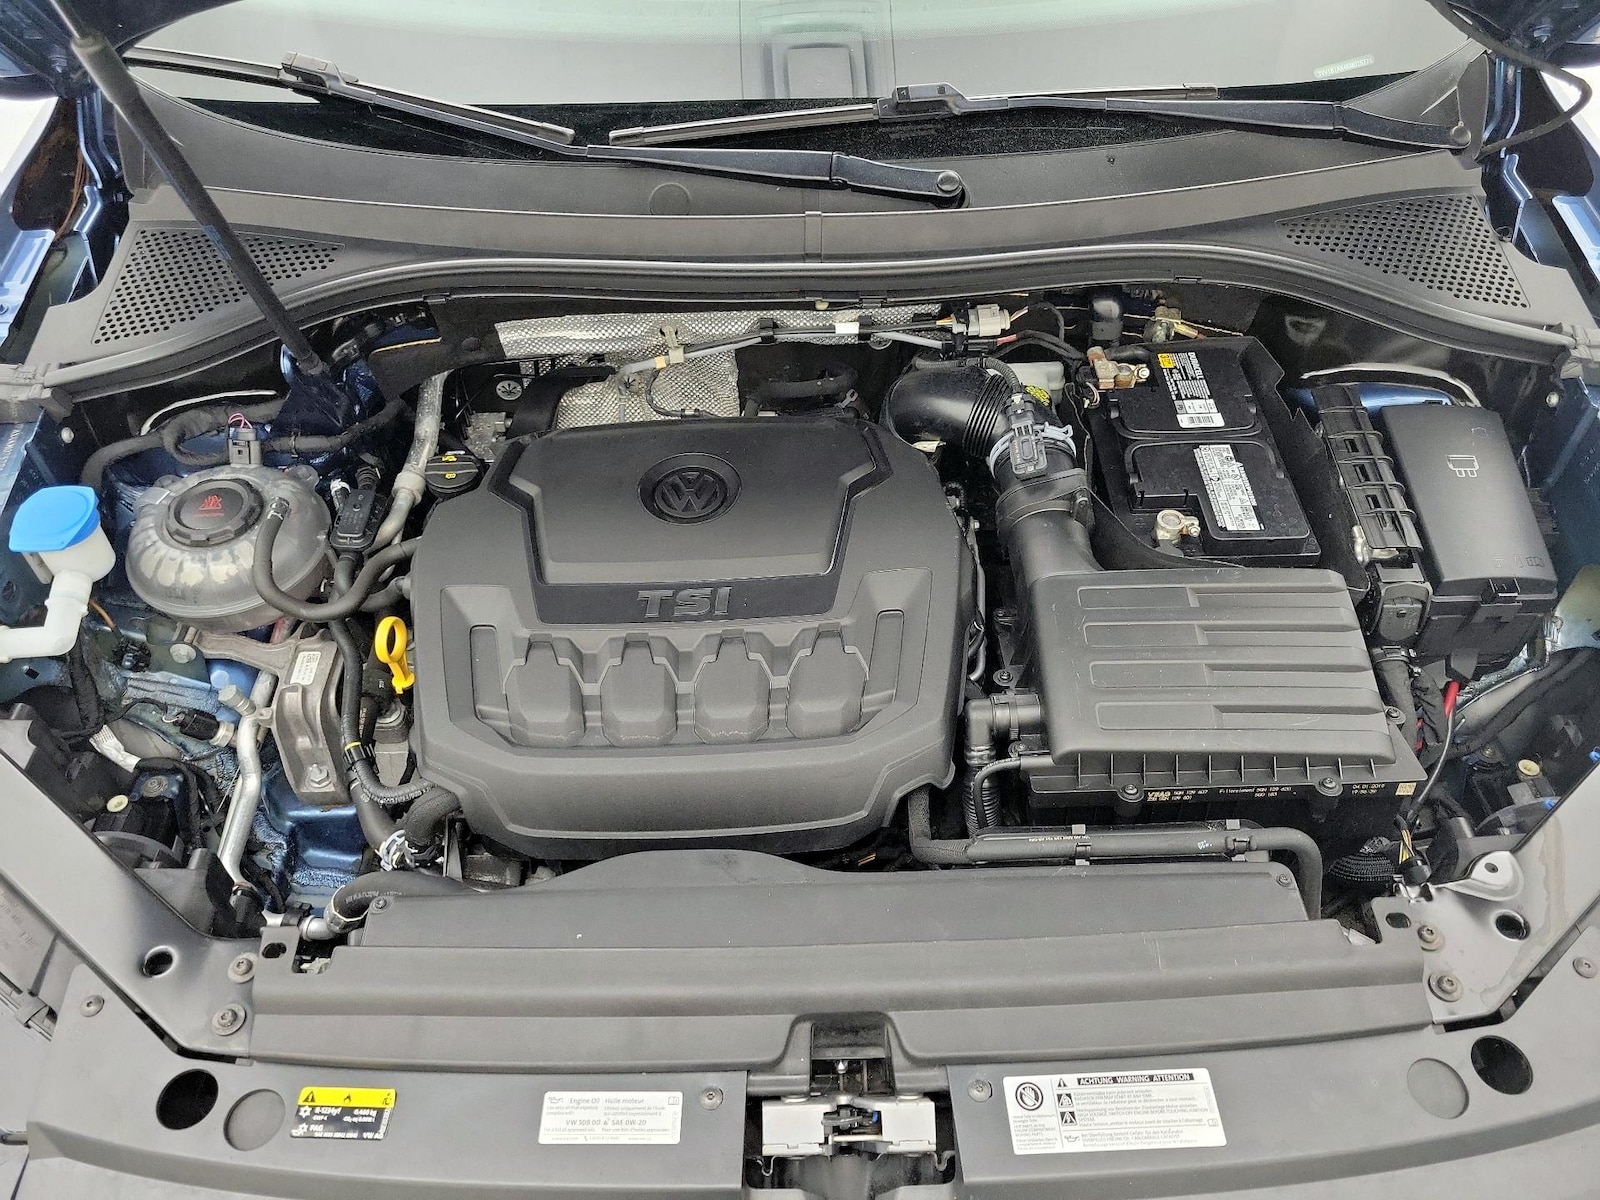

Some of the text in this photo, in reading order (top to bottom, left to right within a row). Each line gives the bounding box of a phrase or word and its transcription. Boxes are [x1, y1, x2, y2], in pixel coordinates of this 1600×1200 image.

[1187, 352, 1204, 380] DURACELL
[636, 587, 733, 618] TSI
[1080, 1073, 1191, 1085] ACHTUNG WARNING ATTENTION
[569, 1097, 591, 1105] Engine
[309, 1124, 324, 1132] PAG
